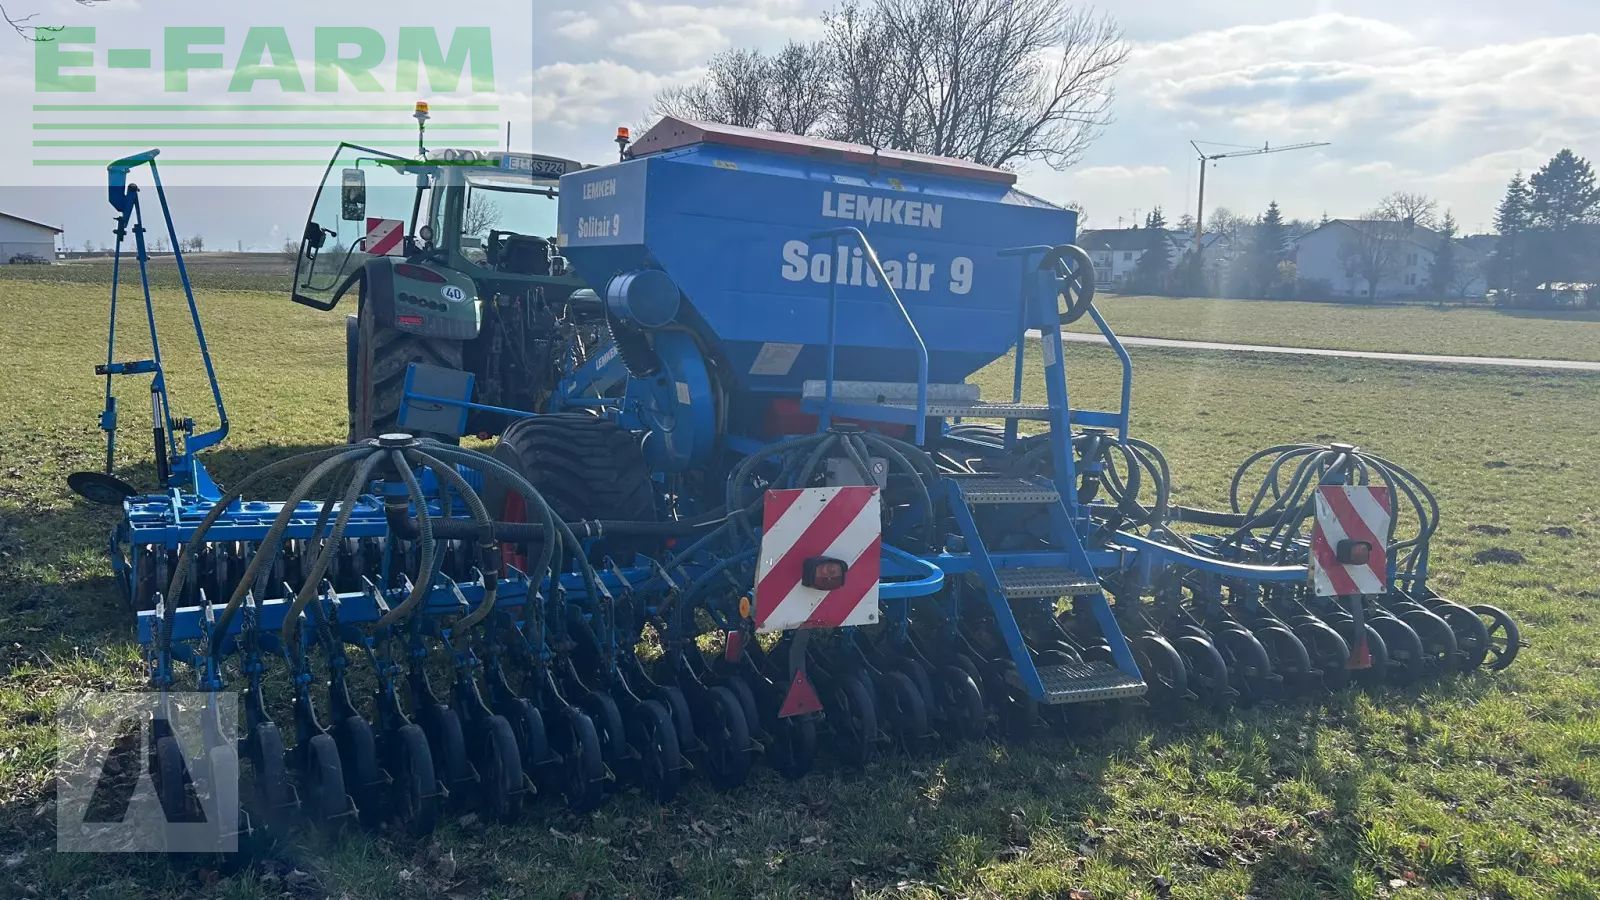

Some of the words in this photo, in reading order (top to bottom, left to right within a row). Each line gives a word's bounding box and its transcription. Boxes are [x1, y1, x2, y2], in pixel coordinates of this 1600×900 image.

[583, 178, 616, 200] LEMKEN
[822, 191, 943, 228] LEMKEN
[578, 215, 610, 238] Solitair
[613, 213, 620, 237] 9
[949, 256, 974, 295] 9
[446, 287, 462, 300] 40
